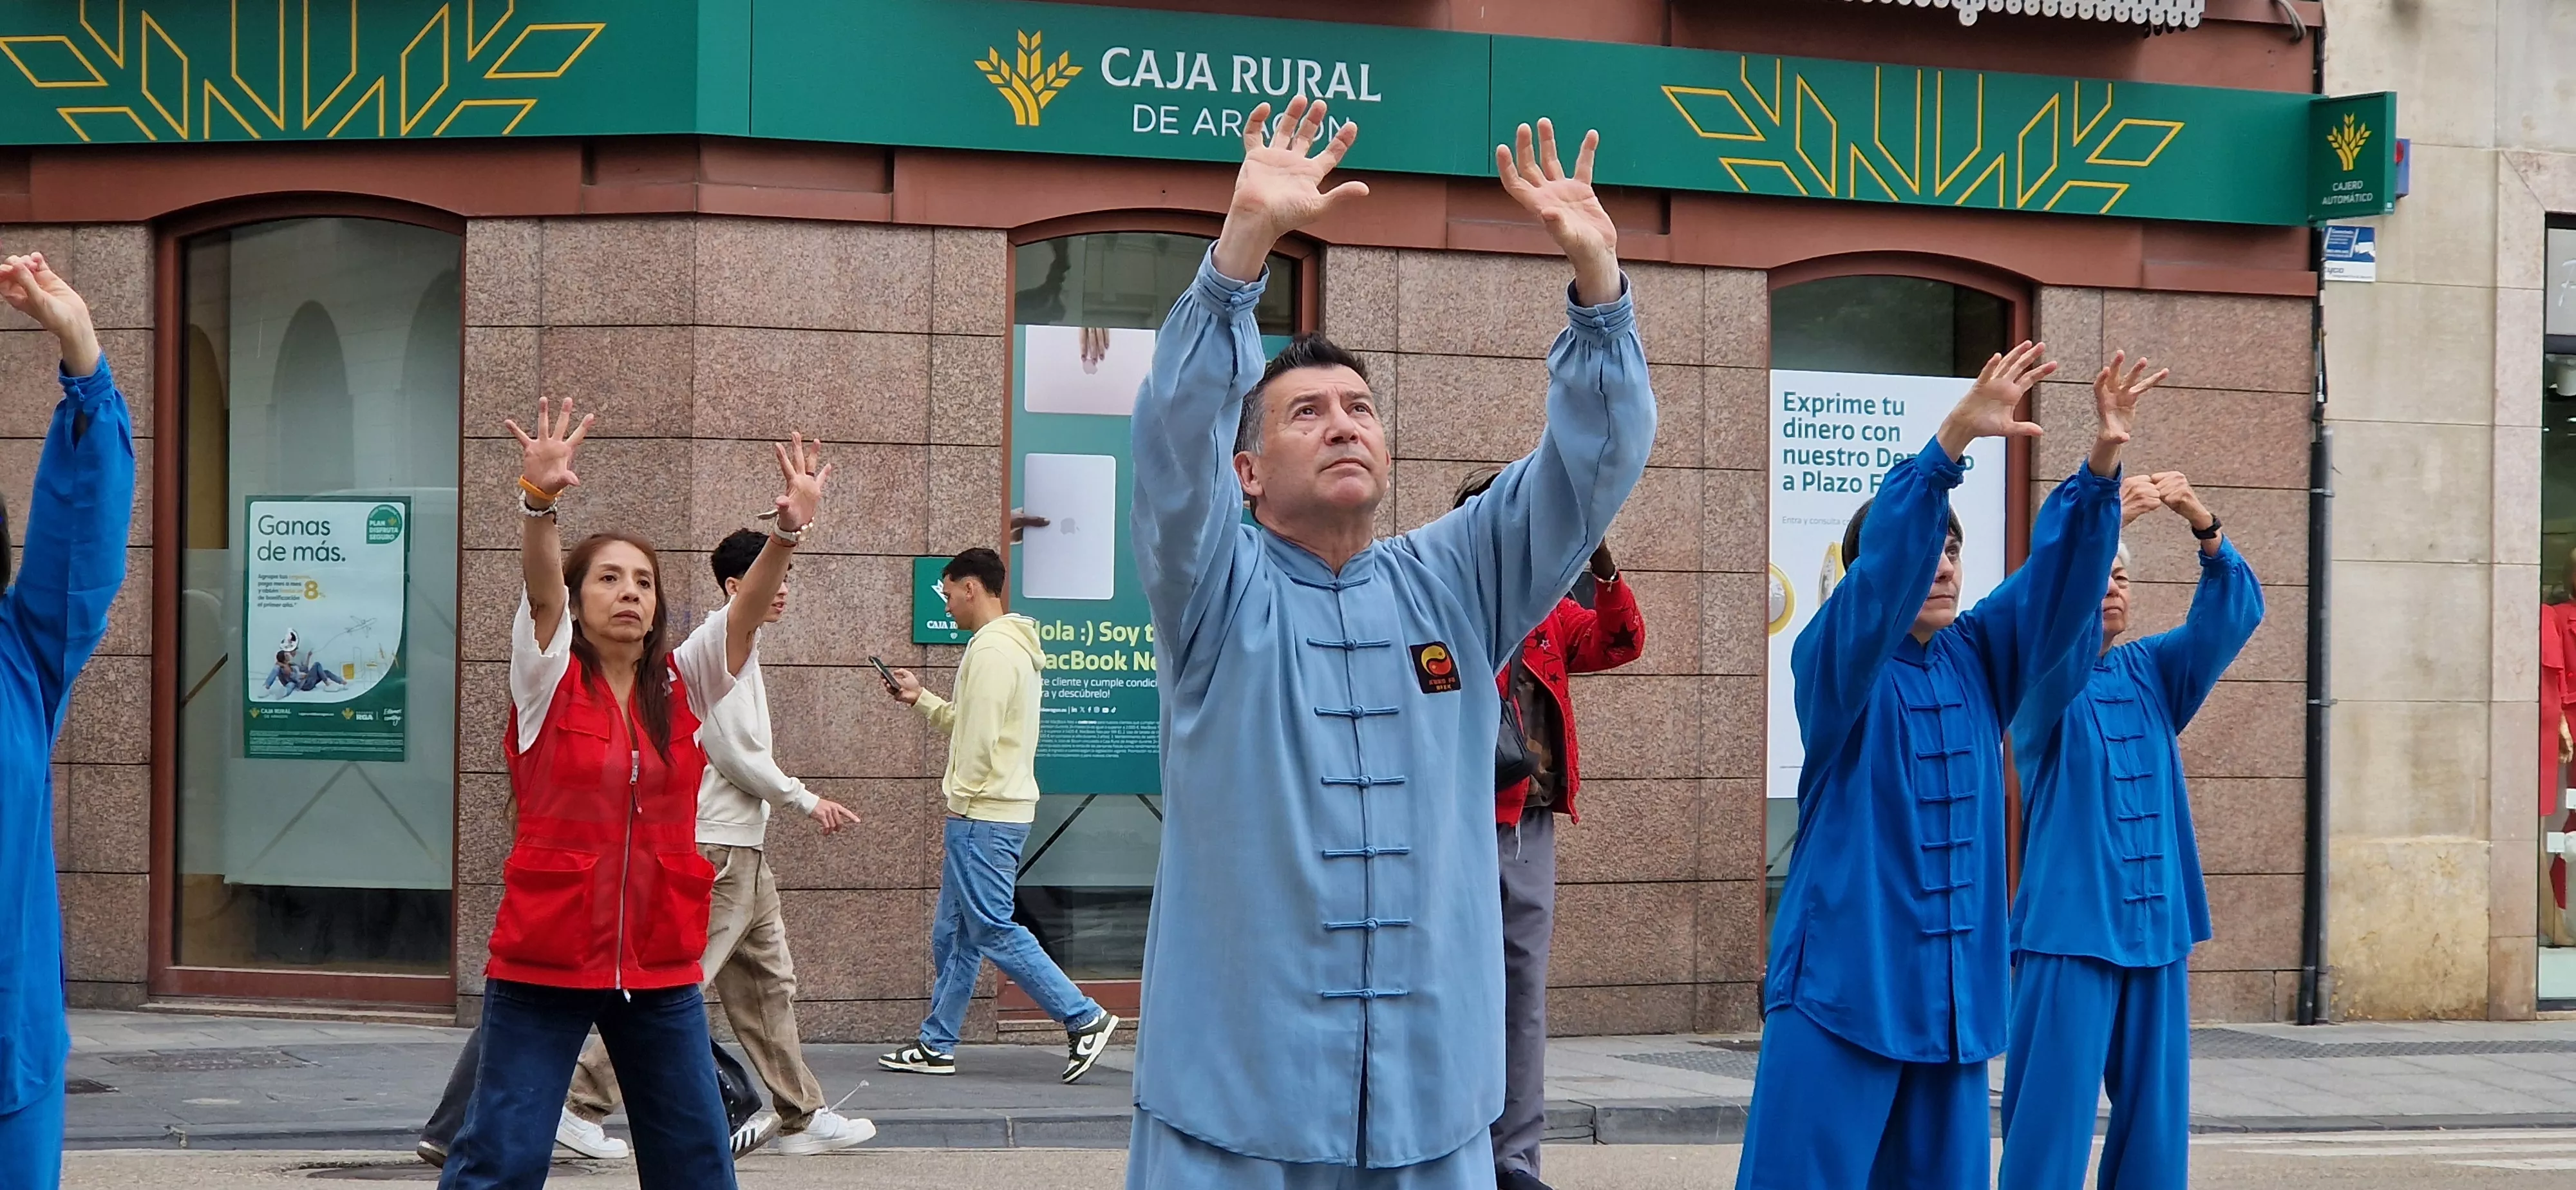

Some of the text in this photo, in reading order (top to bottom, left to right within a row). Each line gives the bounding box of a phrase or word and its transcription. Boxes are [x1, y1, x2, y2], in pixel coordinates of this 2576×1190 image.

[1101, 46, 1382, 102] CAJA RURAL
[1133, 104, 1179, 135] DE
[2333, 180, 2363, 191] CAJERO
[2322, 193, 2373, 205] AUTOMÁTICO
[1783, 391, 1904, 417] Exprime tu
[1783, 417, 1900, 442] dinero con
[1783, 447, 1870, 468] nuestro
[1783, 475, 1794, 491] a
[1803, 471, 1862, 493] Plazo
[258, 515, 330, 536] Ganas
[1809, 517, 1840, 525] consulta
[258, 540, 346, 562] de más.
[927, 620, 949, 629] CAJA
[1099, 621, 1140, 647] Soy
[1052, 677, 1081, 686] cliente
[1083, 679, 1089, 688] y
[1090, 677, 1124, 688] cumple
[1051, 690, 1057, 699] y
[1058, 688, 1110, 699] descúbrelo!
